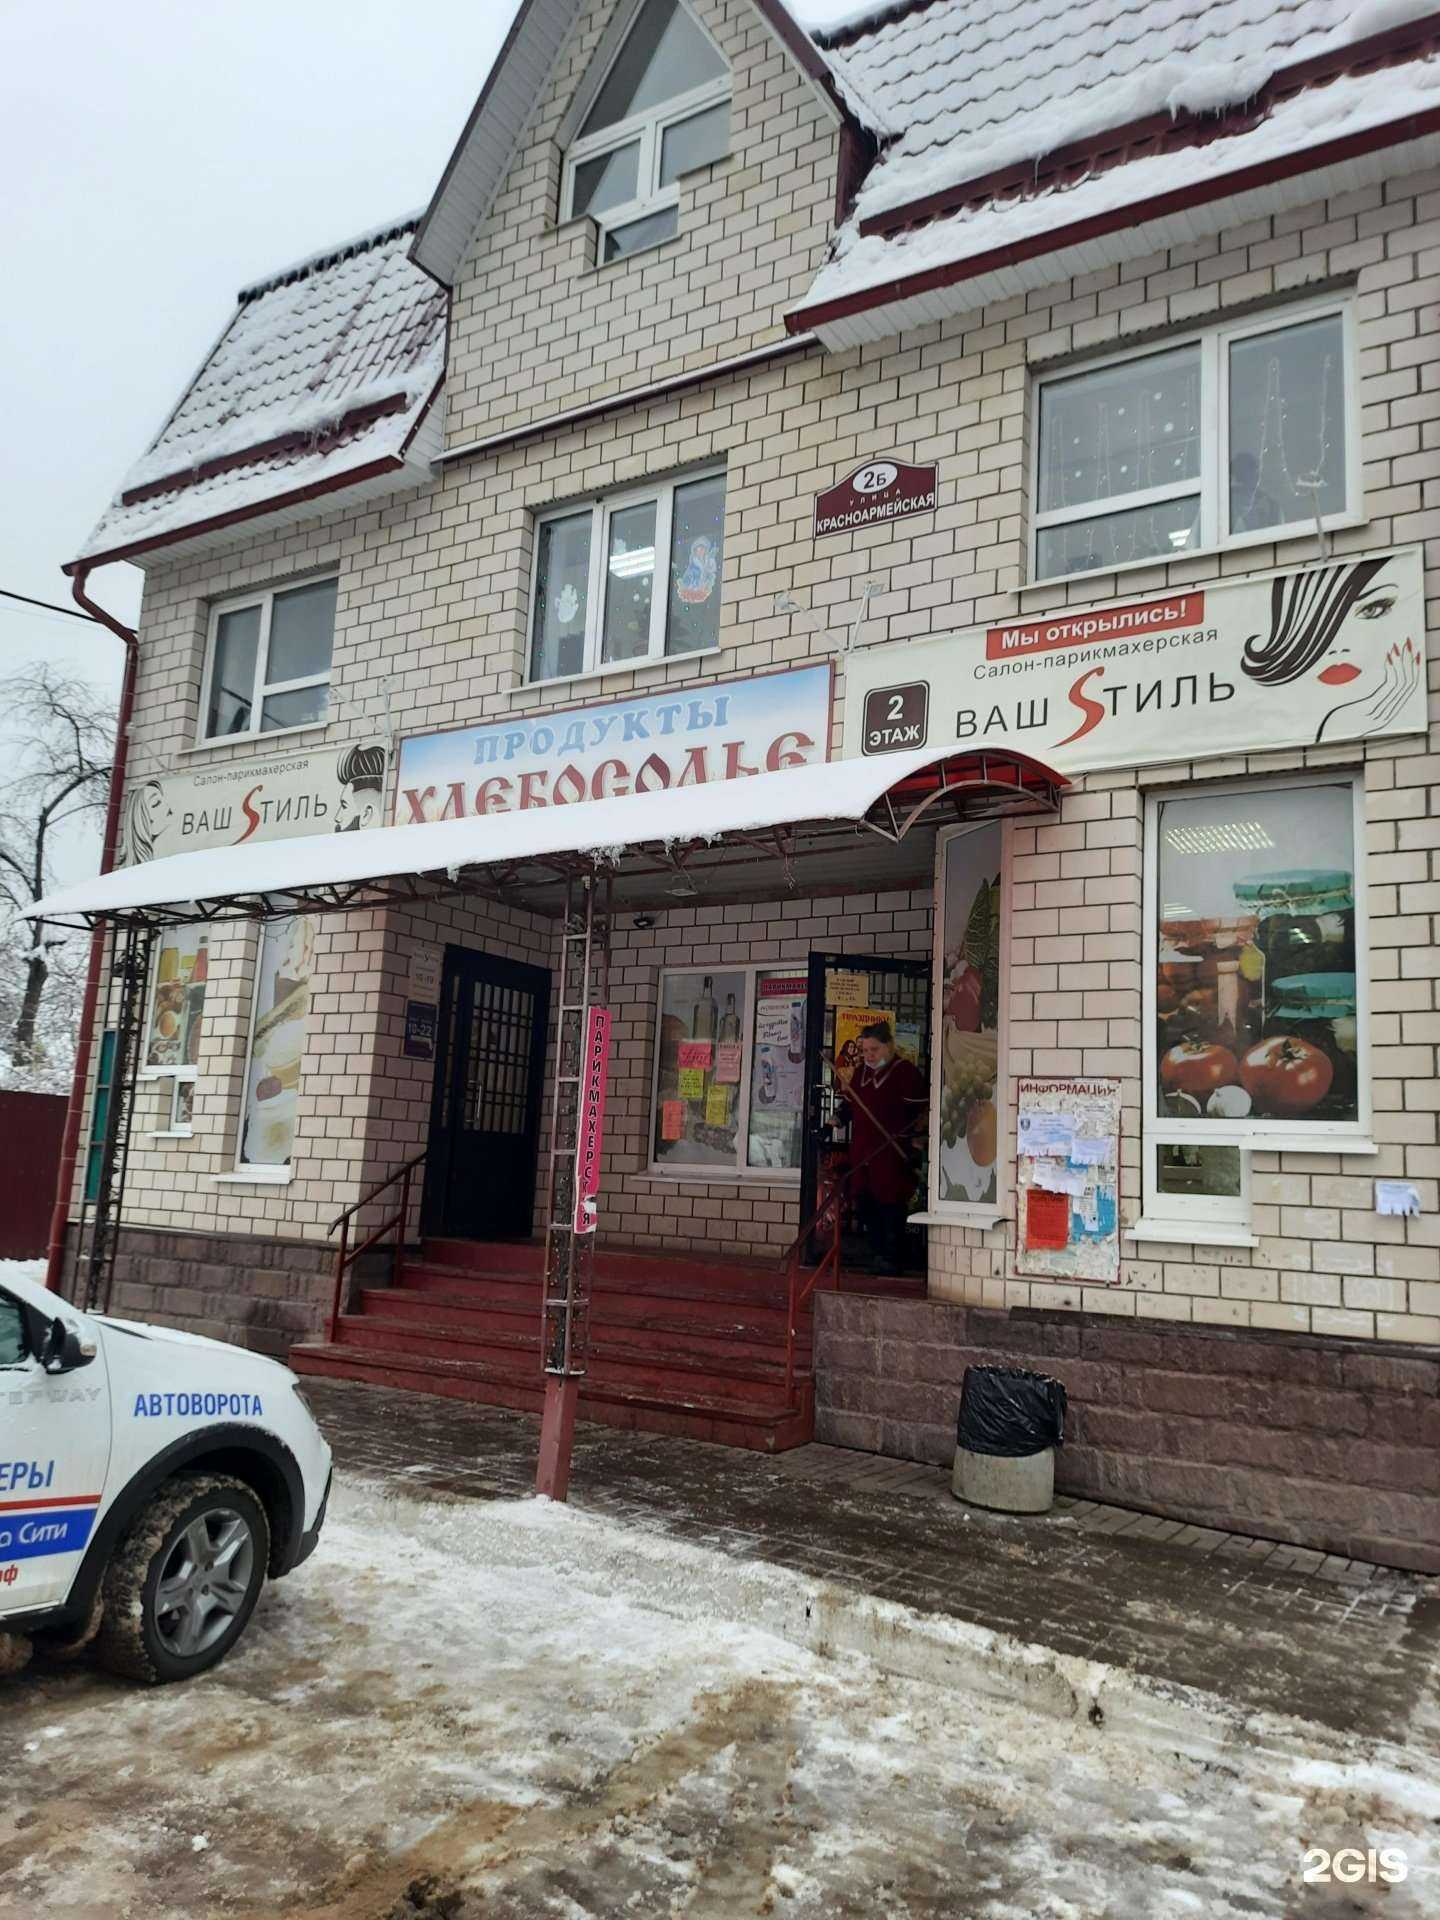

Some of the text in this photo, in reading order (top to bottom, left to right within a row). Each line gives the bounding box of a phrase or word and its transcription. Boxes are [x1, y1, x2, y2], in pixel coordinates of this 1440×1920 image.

[863, 471, 887, 490] 2Б
[816, 492, 935, 533] КРАСНОАРМЕЙСКАЯ
[1001, 599, 1187, 650] Мы открылись!
[973, 629, 1218, 680] Салон-парикмахерская
[886, 695, 904, 721] 2
[956, 697, 1049, 739] ВАШ
[473, 695, 732, 766] ПРОДУКТЫ
[868, 724, 921, 747] ЭТАЖ
[193, 758, 310, 788] Салон-парикмахерская
[181, 806, 233, 836] ВАШ
[133, 1393, 263, 1417] АВТОВОРОТА
[19, 1522, 68, 1545] Сити
